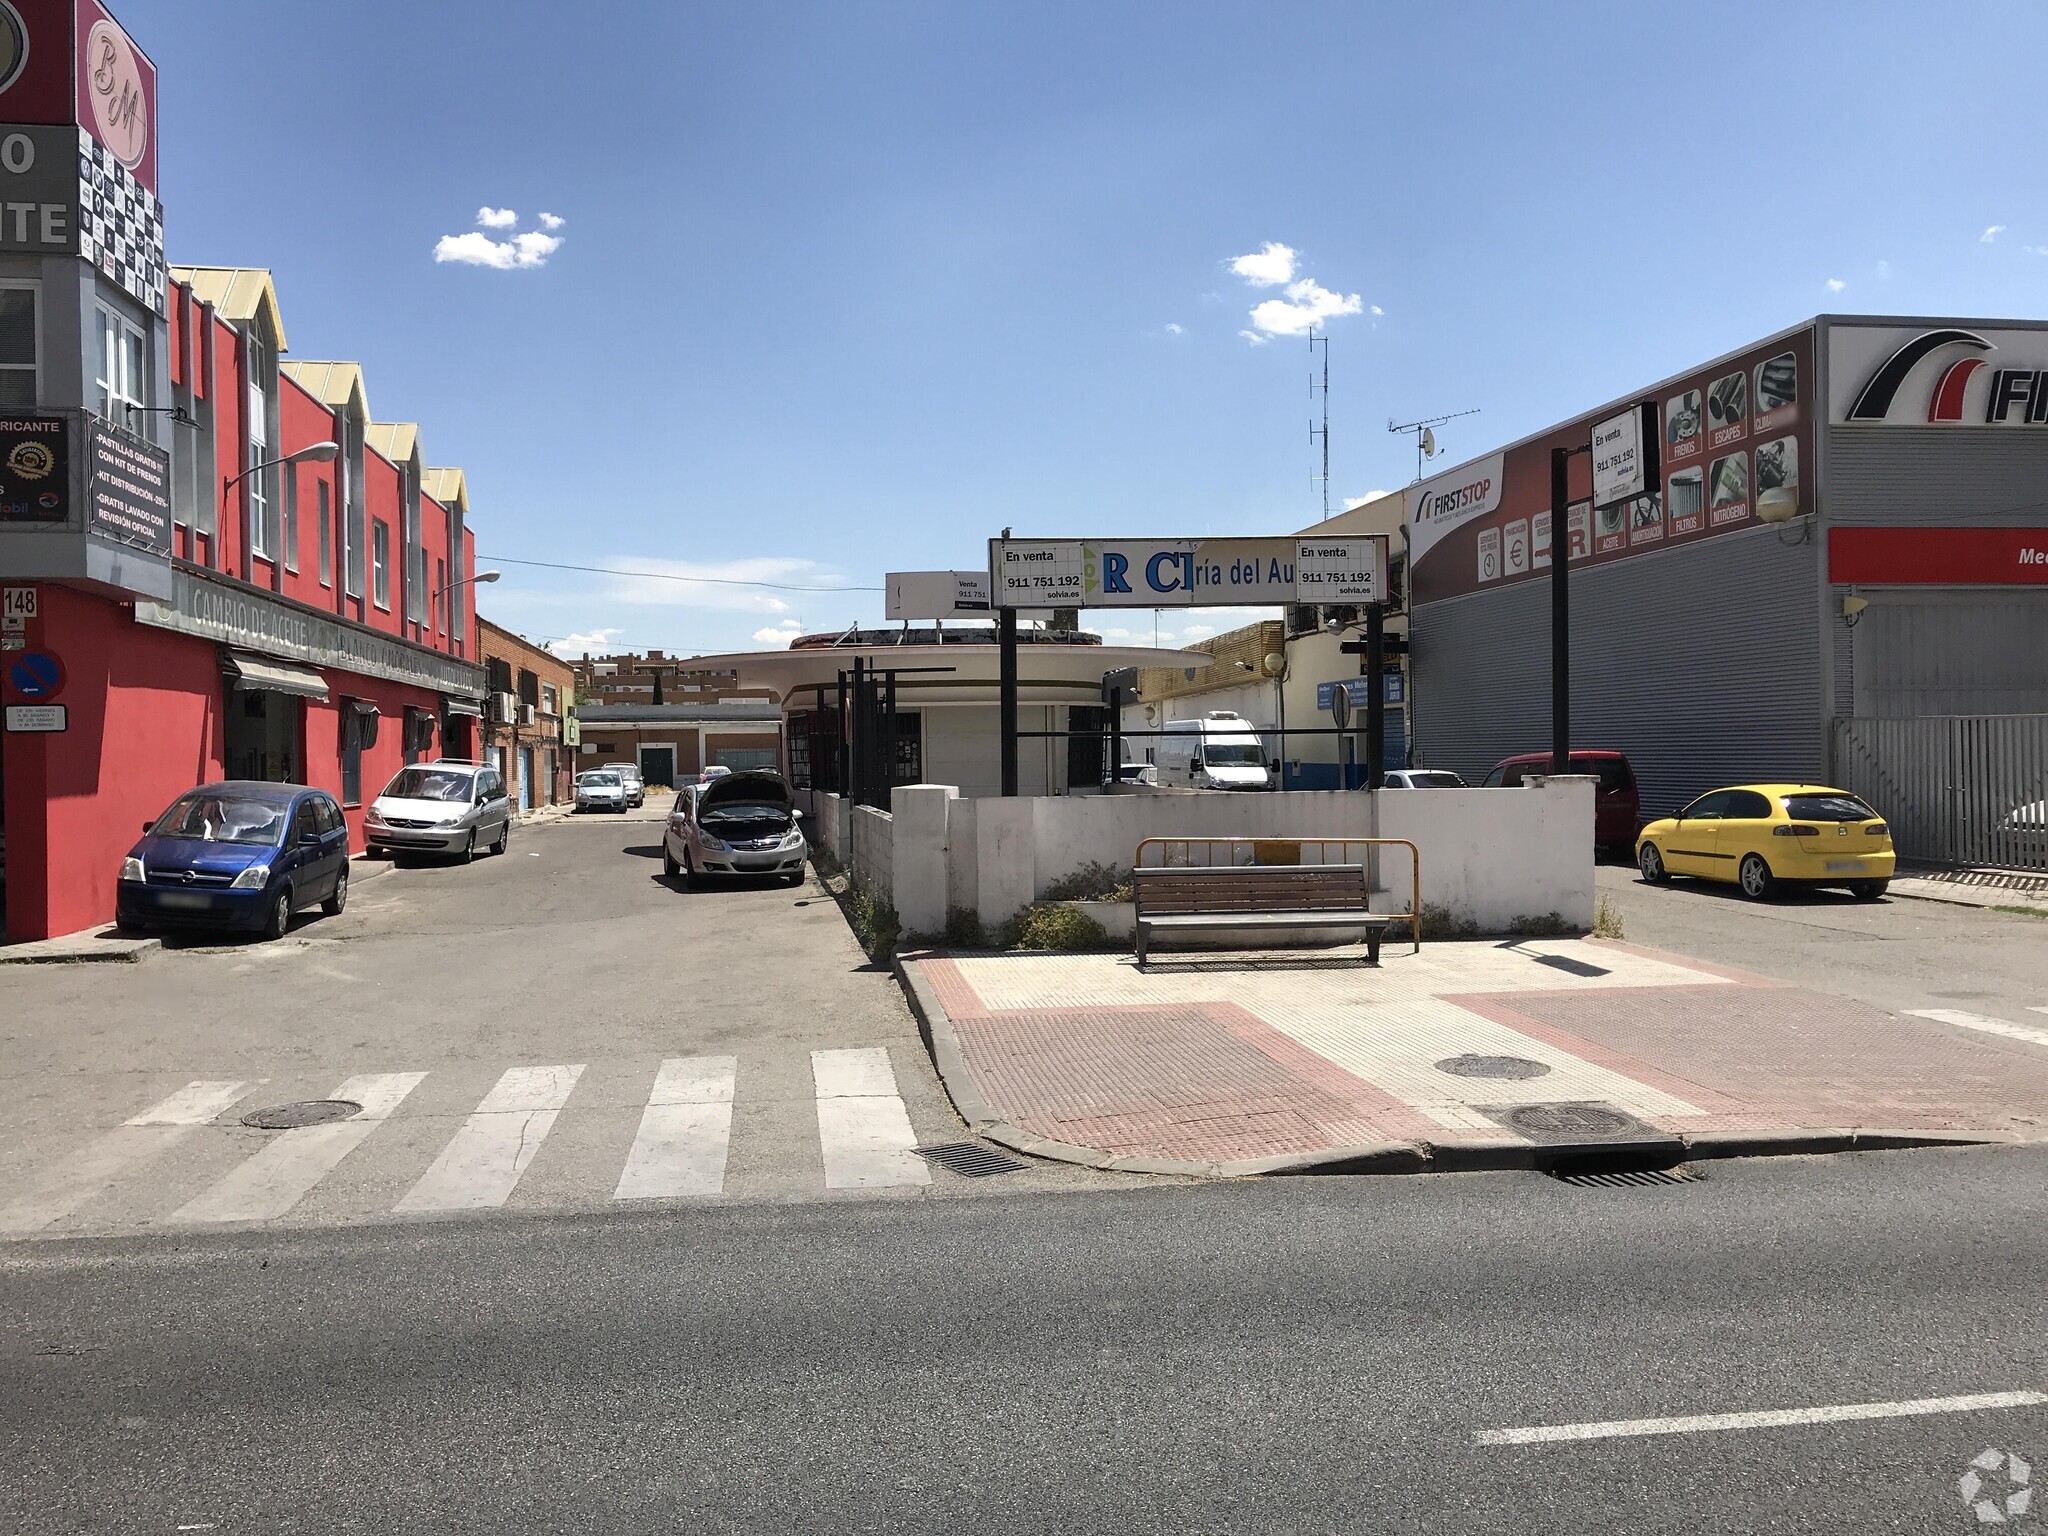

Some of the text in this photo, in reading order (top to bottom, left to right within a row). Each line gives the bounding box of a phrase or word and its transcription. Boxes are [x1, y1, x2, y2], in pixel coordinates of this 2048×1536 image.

[0, 202, 67, 244] TE
[1595, 428, 1621, 446] En venta
[1714, 425, 1741, 445] ESCAPES
[1674, 441, 1695, 458] FRENOS
[98, 449, 161, 487] CON KIT DE FRENOS
[134, 452, 156, 470] GRATIS
[1597, 448, 1634, 473] 911 751 192
[111, 475, 153, 502] DISTRIBUCIÓN
[0, 503, 29, 513] obil
[125, 503, 150, 520] LAVADO
[150, 513, 164, 527] CON
[1713, 503, 1746, 523] NITRÓGENO
[98, 508, 157, 539] REVISIÓN OFICIAL
[1676, 516, 1697, 532] FILTROS
[1301, 546, 1347, 558] En venta
[1603, 536, 1618, 550] ACEITE
[1005, 550, 1054, 562] En venta
[1230, 557, 1260, 585] del
[1267, 556, 1294, 585] Au
[1302, 571, 1371, 583] 911 751 192
[958, 580, 978, 589] Venta
[1007, 575, 1080, 588] 911 751 192
[1339, 585, 1371, 595] solvia.es
[5, 591, 35, 613] 148
[958, 590, 986, 598] 911 751
[1047, 590, 1080, 600] solvia.es
[193, 588, 307, 651] CAMBIO DE ACEITE
